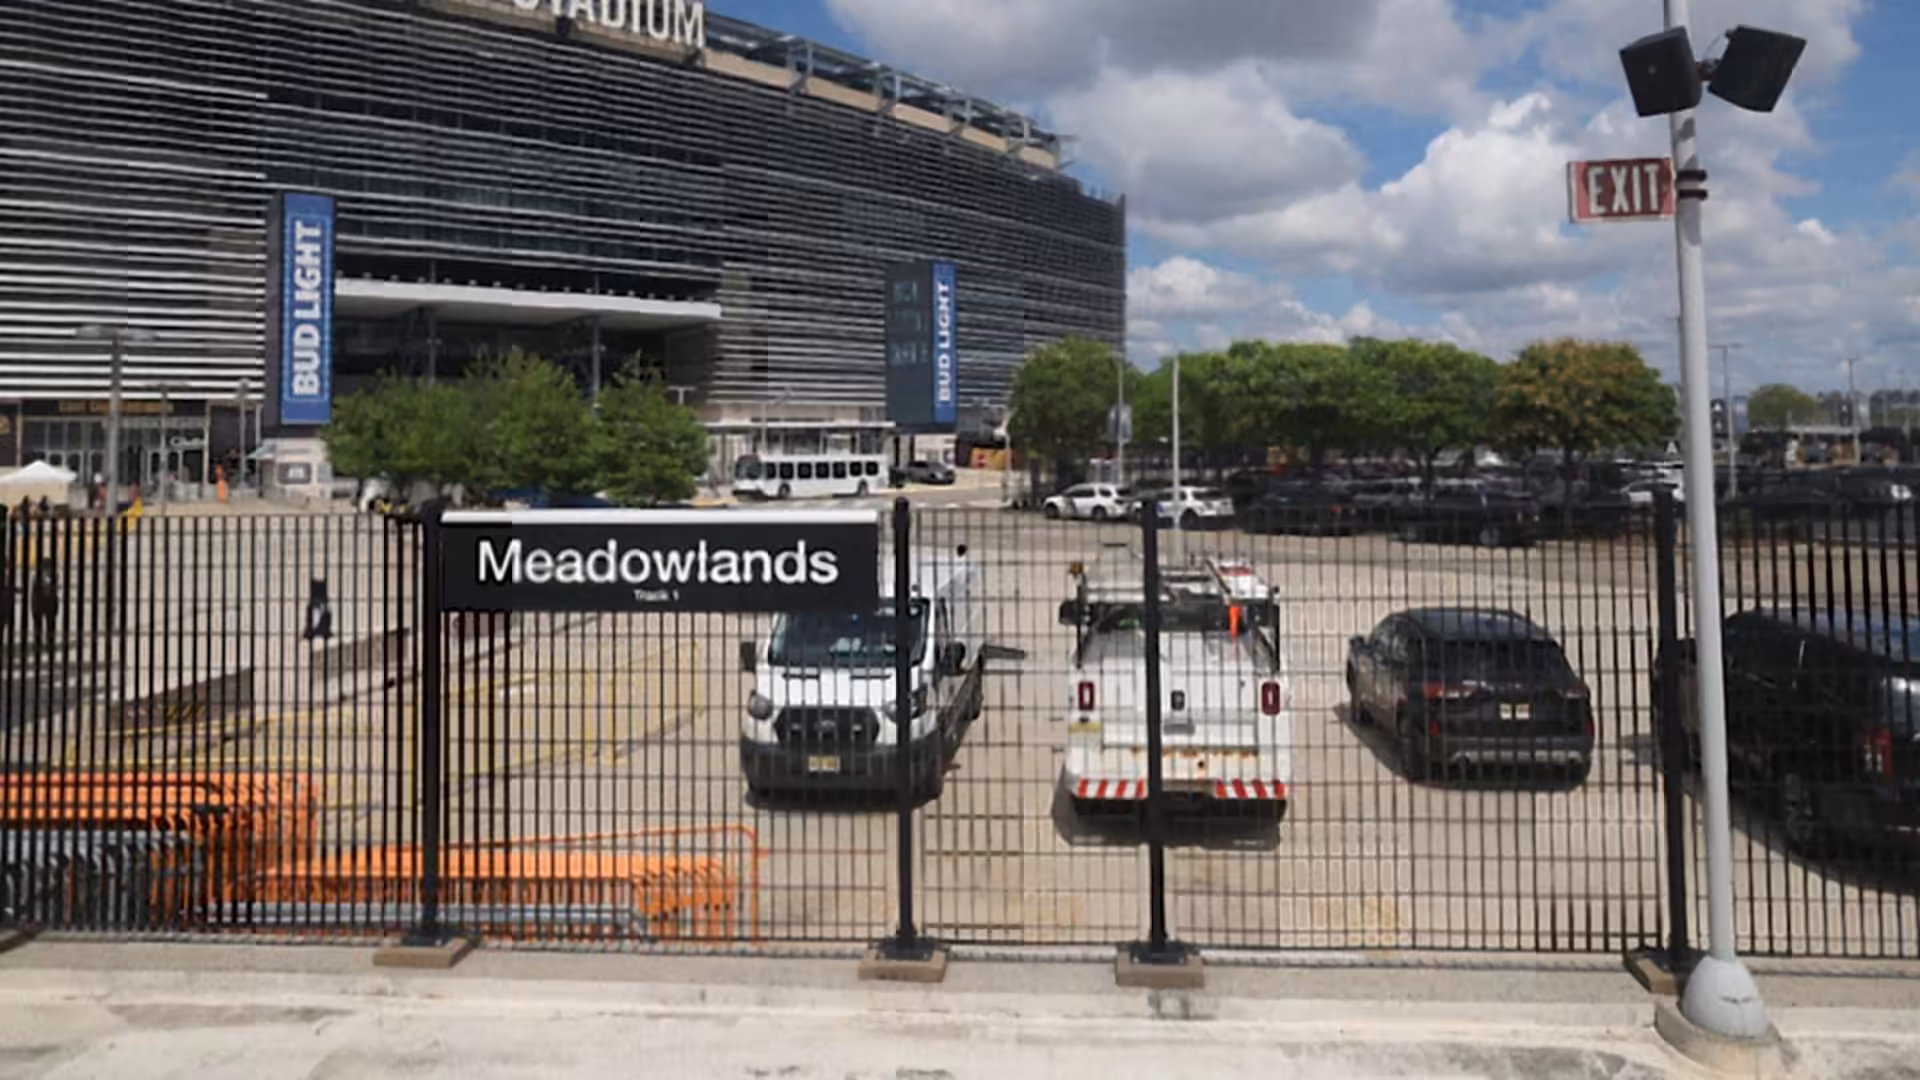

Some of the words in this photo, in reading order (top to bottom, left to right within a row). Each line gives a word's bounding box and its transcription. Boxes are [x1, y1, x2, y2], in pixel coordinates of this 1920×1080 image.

[512, 0, 706, 48] DIUM
[1587, 163, 1660, 215] EXIT
[294, 219, 322, 320] LIGHT
[937, 281, 950, 349] LIGHT
[291, 323, 321, 396] BUD
[938, 353, 950, 401] BUD
[477, 538, 840, 584] Meadowlands
